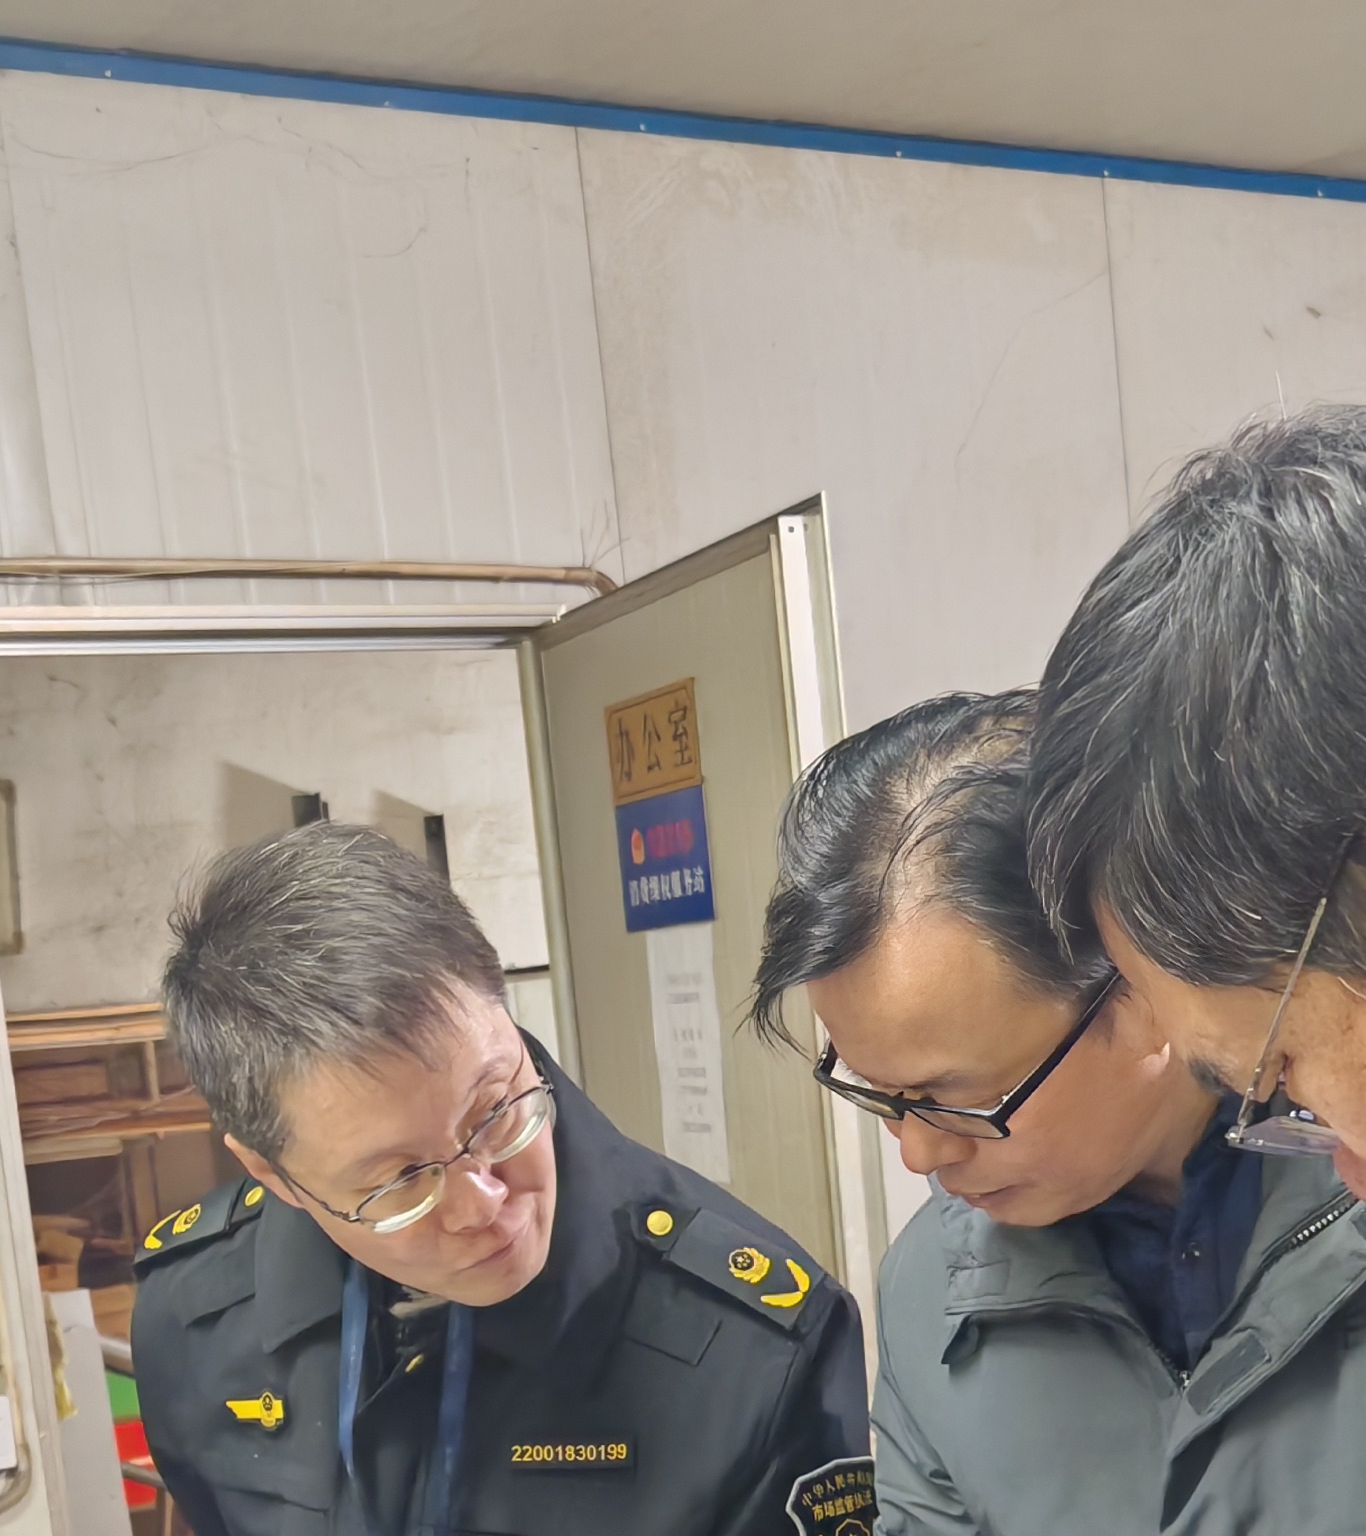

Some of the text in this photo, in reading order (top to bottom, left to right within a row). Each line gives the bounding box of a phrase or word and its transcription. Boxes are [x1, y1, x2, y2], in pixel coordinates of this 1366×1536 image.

[616, 702, 693, 782] 办公室
[510, 1442, 628, 1464] 22001830199
